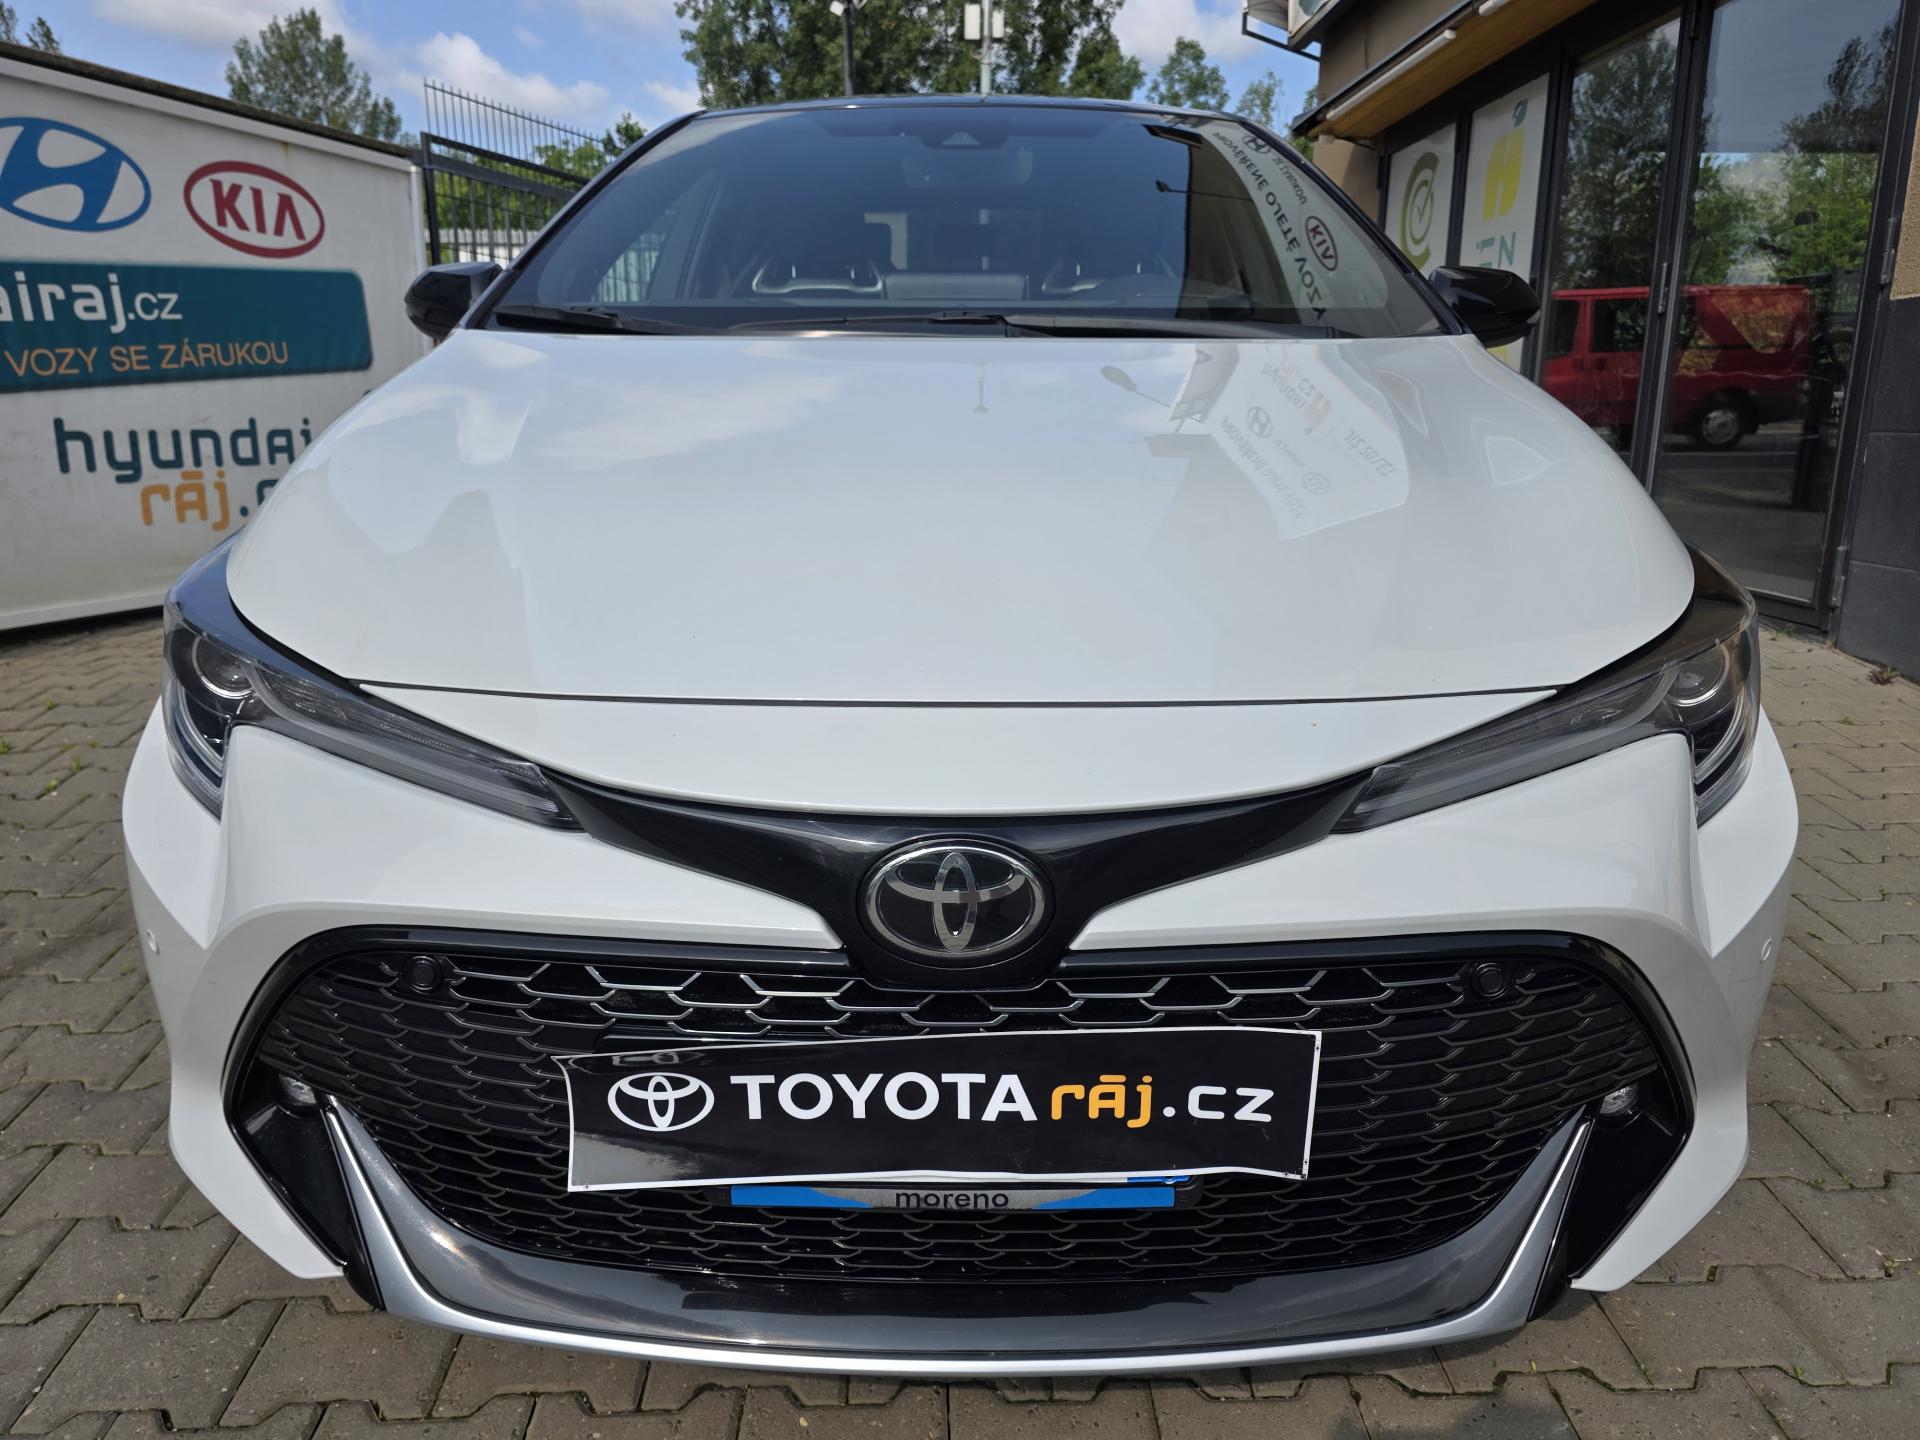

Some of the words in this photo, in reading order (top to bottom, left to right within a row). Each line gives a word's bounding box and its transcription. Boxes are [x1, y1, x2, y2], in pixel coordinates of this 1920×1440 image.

[210, 178, 306, 241] KIA
[4, 348, 98, 376] VOZY
[110, 344, 151, 371] SE
[158, 338, 288, 369] ZÁRUKOU
[730, 1072, 1038, 1121] TOYOTA
[895, 1188, 1009, 1209] moreno
